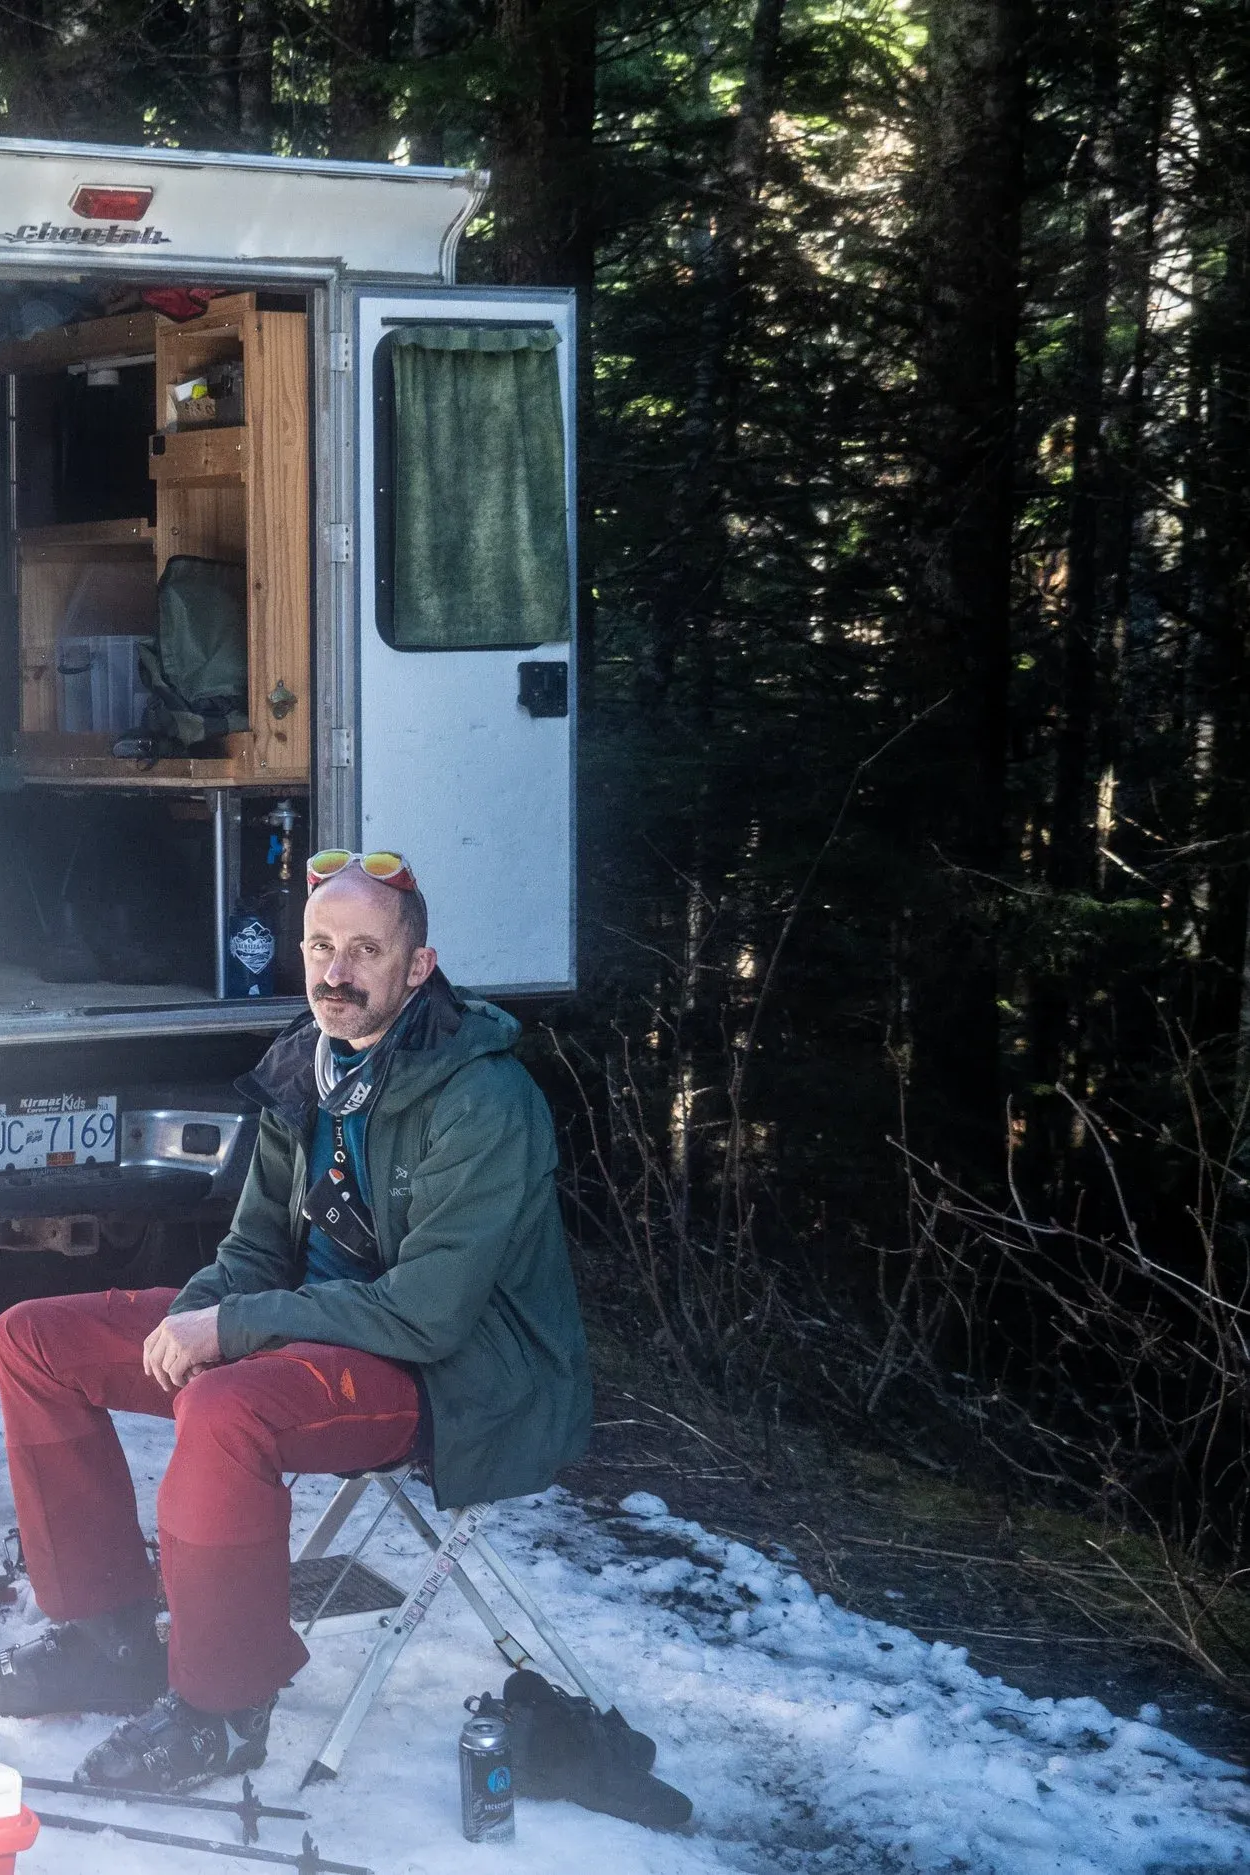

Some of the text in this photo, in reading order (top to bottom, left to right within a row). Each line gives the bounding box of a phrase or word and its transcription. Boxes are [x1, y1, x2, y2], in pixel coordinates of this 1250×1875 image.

[10, 221, 164, 247] cheetah
[19, 1097, 62, 1110] Kirmac
[61, 1093, 87, 1112] Kids
[44, 1112, 116, 1152] 7169
